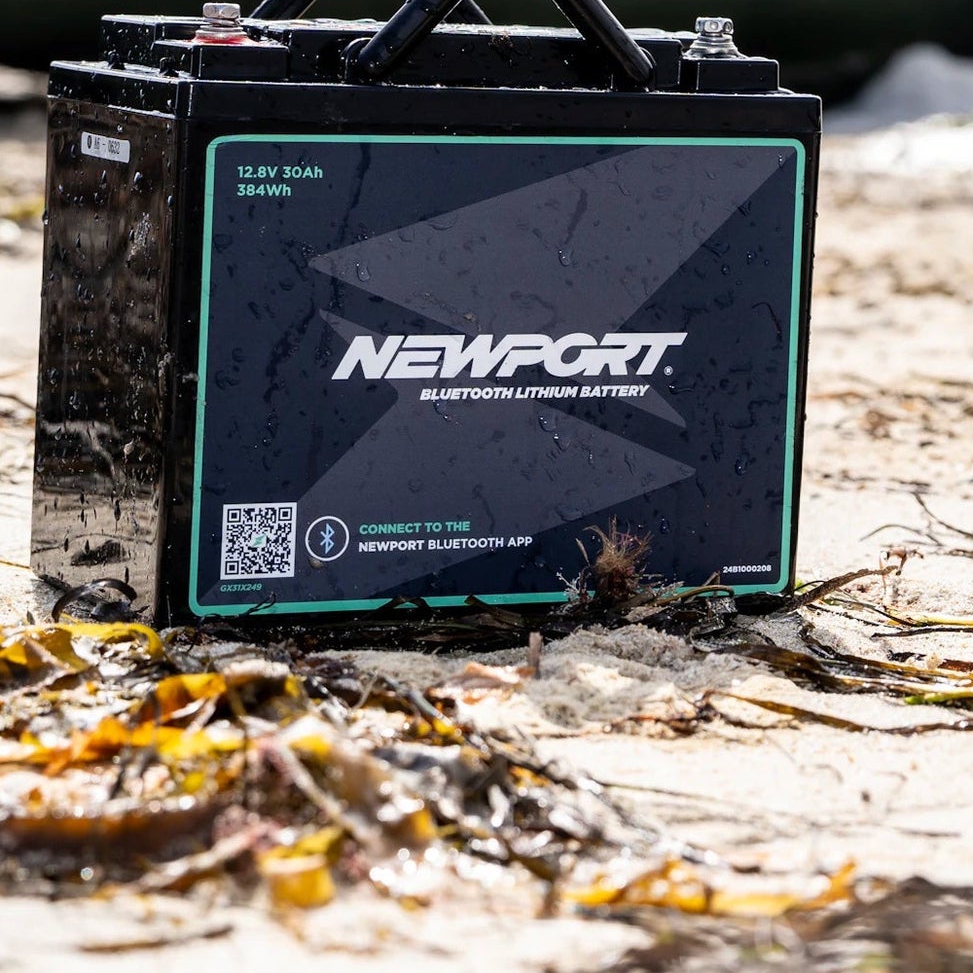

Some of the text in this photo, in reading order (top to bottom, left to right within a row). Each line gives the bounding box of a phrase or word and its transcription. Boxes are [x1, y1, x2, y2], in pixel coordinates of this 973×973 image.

[237, 166, 323, 178] 12.8V 30Ah
[237, 184, 291, 196] 384Wh
[332, 332, 688, 379] NEWPORT
[420, 385, 650, 401] BLUETOOTH LITHIUM BATTERY
[359, 521, 471, 535] CONNECT TO THE
[358, 536, 533, 553] NEWPORT BLUETOOTH APP
[722, 564, 772, 574] 24B1000208
[220, 583, 263, 593] GX31X249
